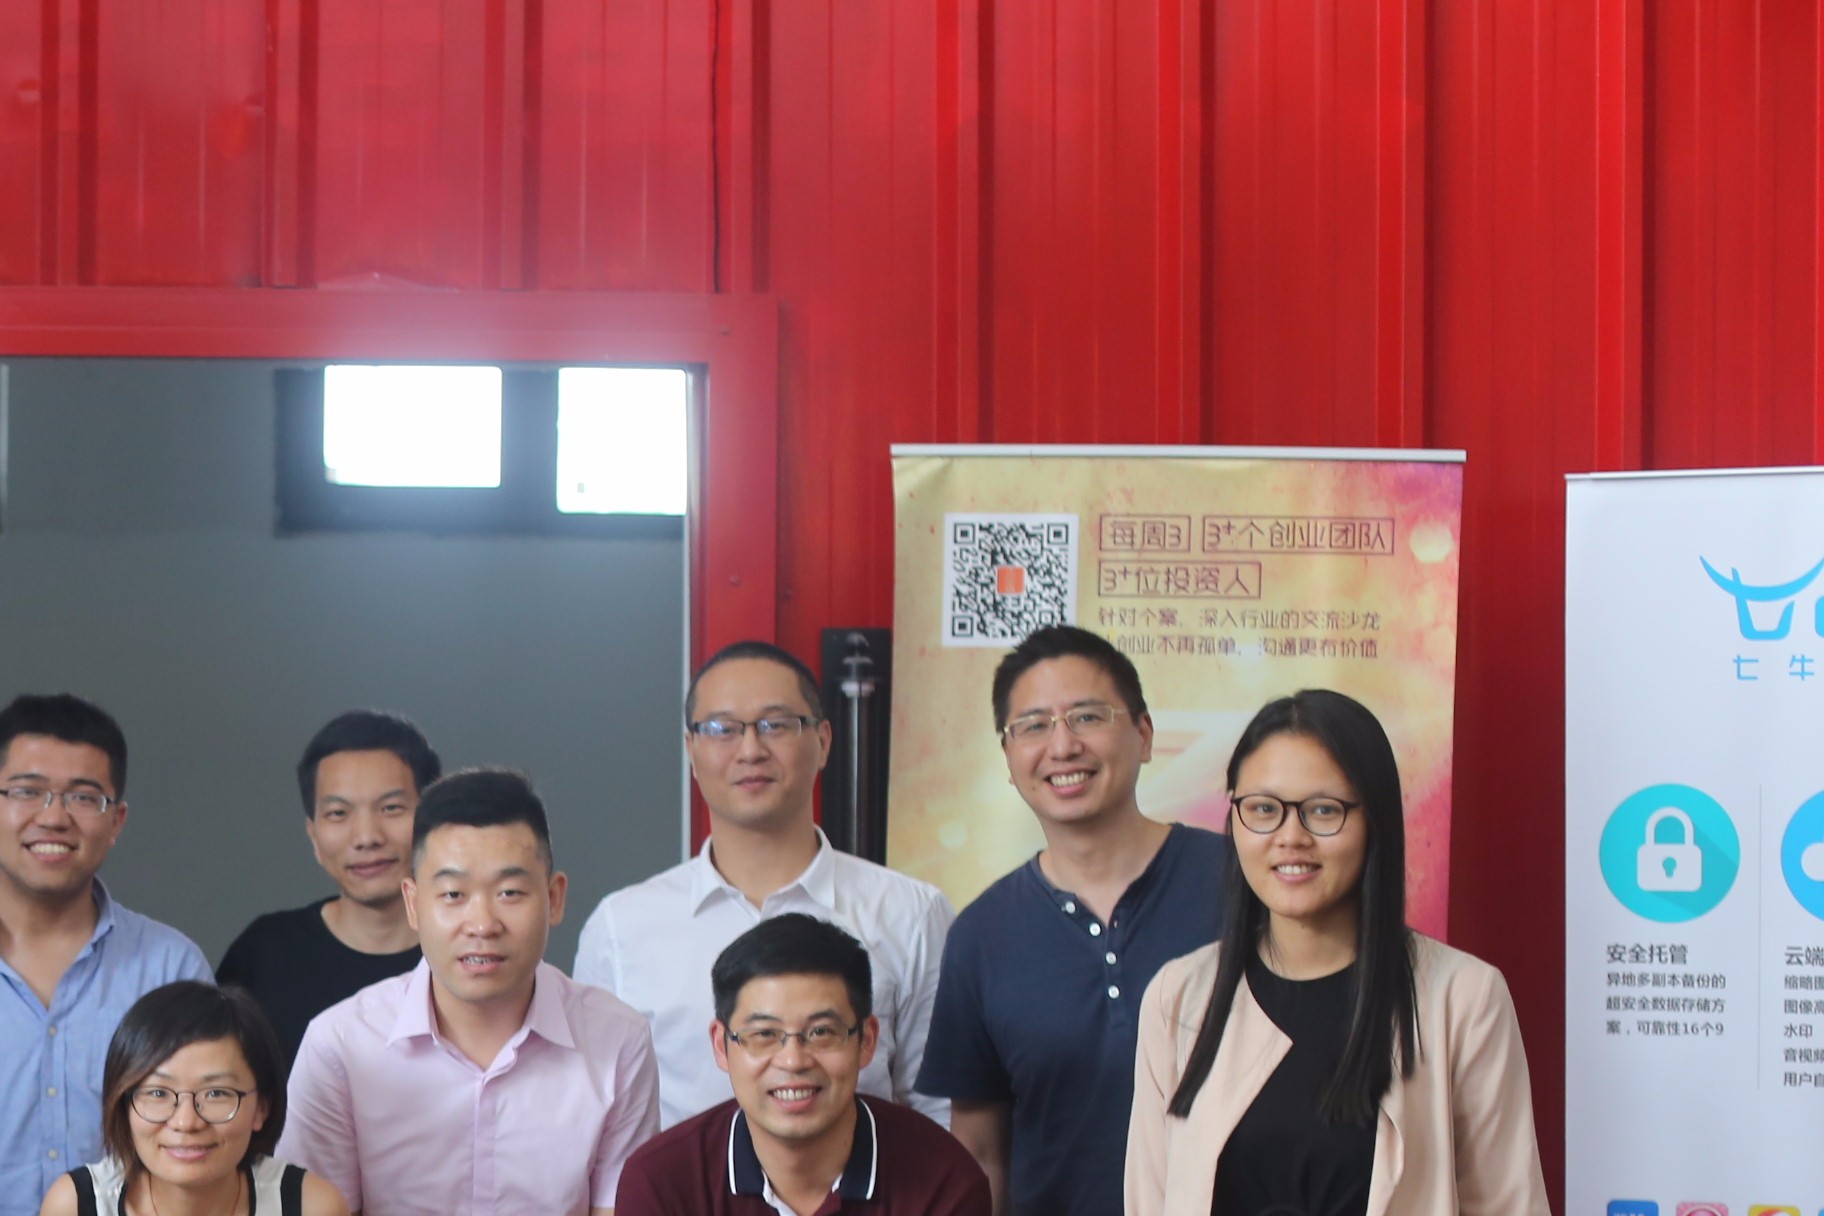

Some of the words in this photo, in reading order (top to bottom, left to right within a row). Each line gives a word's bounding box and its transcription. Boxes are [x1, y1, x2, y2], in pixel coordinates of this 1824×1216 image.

[1108, 520, 1183, 550] 每周3
[1605, 943, 1689, 965] 安全托管
[1606, 972, 1727, 989] 异地多副本备份的
[1605, 996, 1726, 1013] 超安全数据存储方
[1784, 1023, 1814, 1039] 水印
